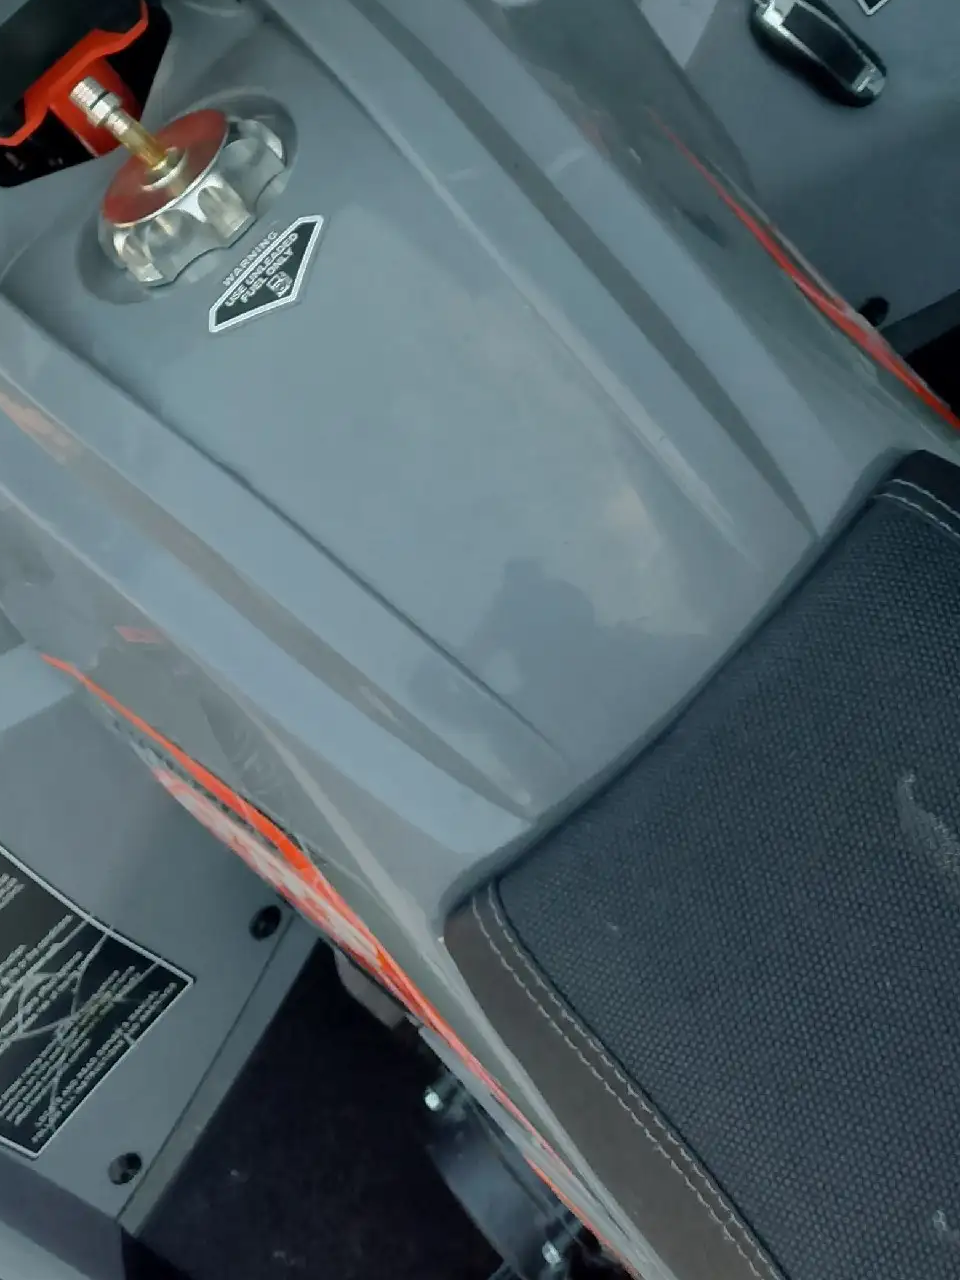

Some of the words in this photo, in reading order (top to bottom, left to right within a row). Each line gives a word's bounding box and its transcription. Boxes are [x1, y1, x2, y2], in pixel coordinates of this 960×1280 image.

[223, 231, 278, 286] WARNING
[225, 284, 247, 306] USE
[245, 233, 298, 285] UNLEADED
[240, 274, 268, 303] FUEL
[265, 247, 294, 276] ONLY
